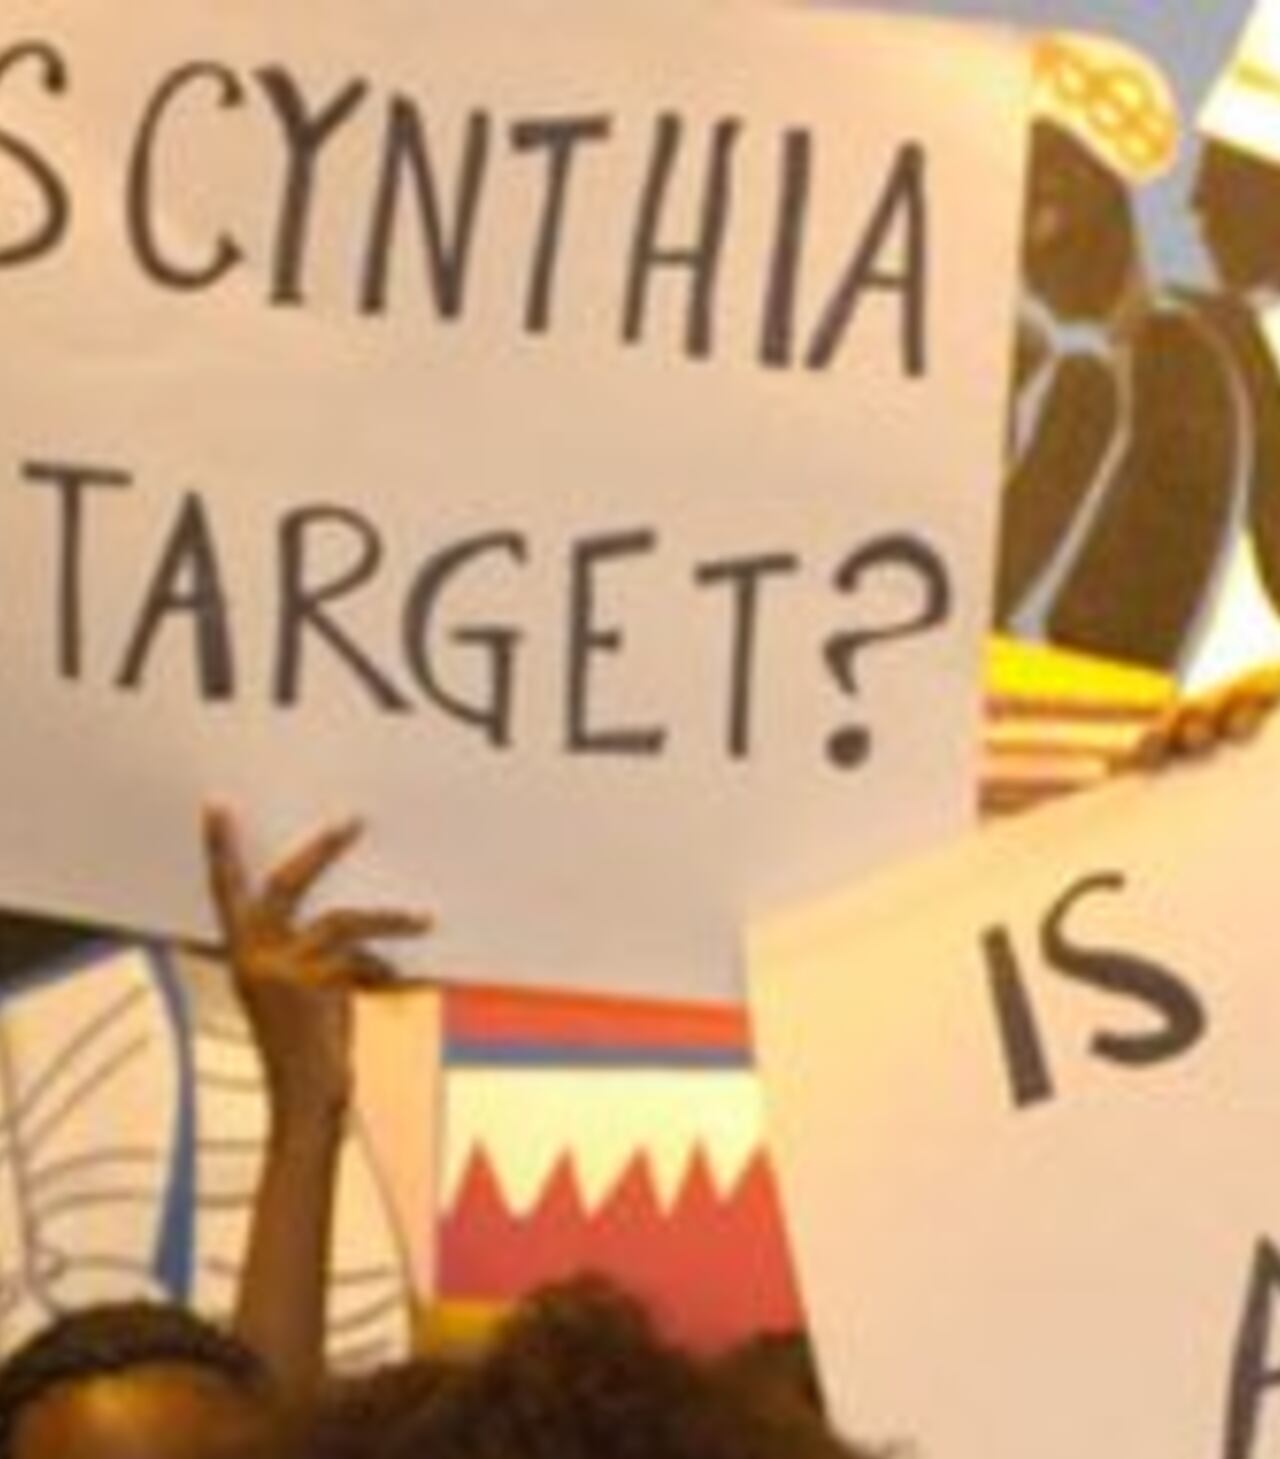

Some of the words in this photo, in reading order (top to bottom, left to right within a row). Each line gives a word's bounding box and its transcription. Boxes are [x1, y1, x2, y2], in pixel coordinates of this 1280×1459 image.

[126, 60, 926, 378] CYNTHIA
[21, 461, 952, 771] TARGET?
[980, 872, 1207, 1109] IS
